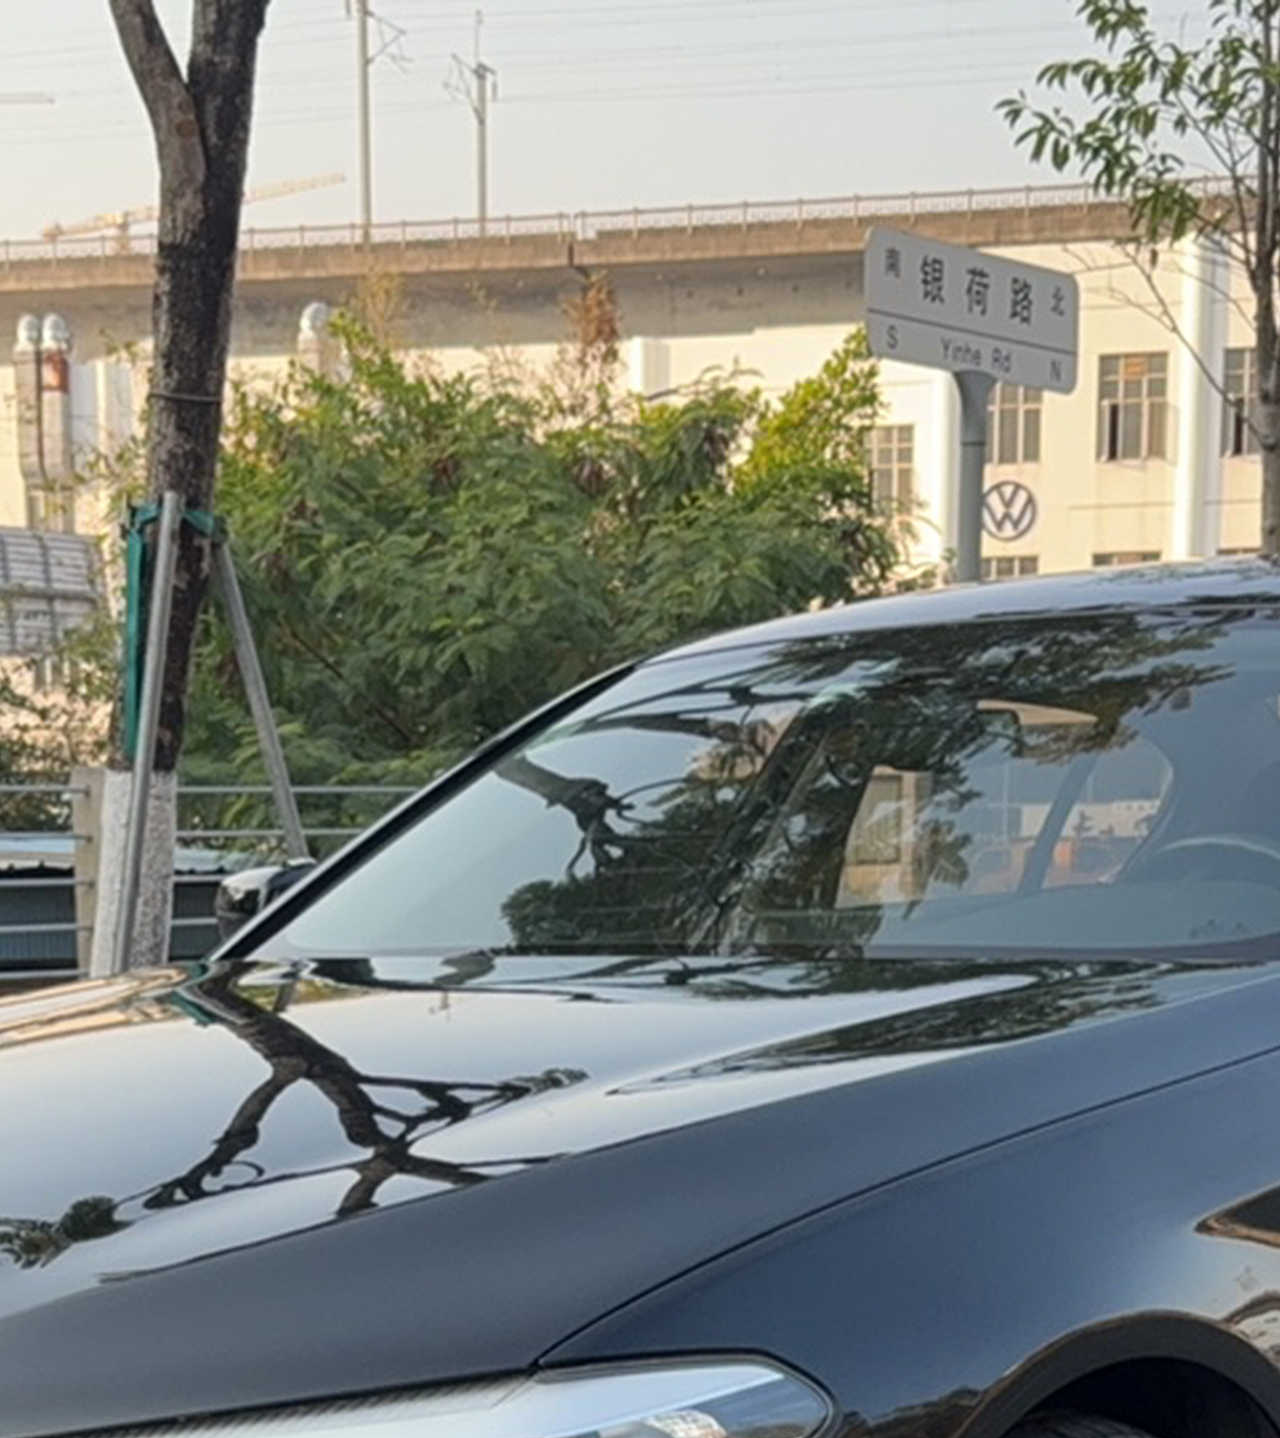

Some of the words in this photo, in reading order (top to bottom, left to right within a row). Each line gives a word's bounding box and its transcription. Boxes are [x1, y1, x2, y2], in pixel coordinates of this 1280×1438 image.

[920, 254, 1033, 326] 银荷路
[887, 325, 898, 349] S
[992, 346, 1012, 373] Rd
[1050, 360, 1062, 382] N
